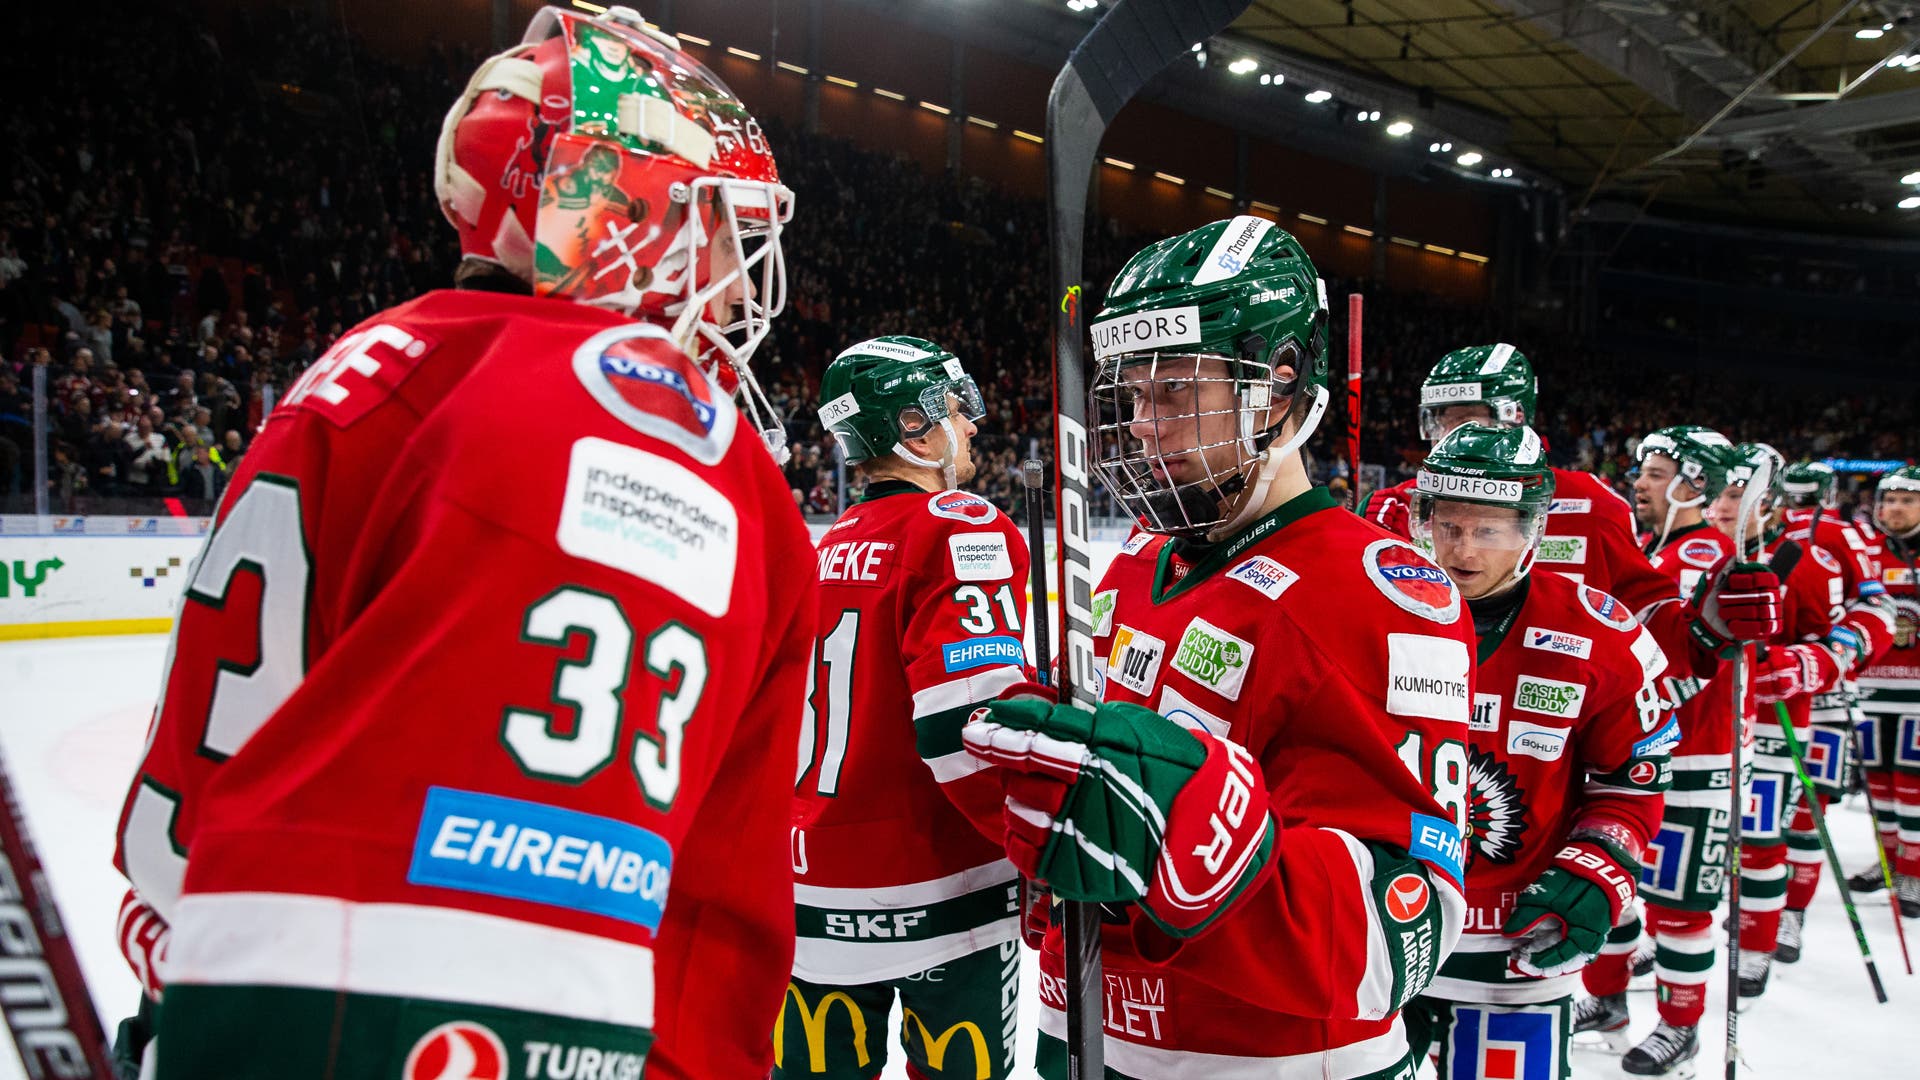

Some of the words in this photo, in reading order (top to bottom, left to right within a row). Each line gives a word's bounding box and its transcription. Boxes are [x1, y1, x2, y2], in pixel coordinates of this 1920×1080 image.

[605, 358, 712, 423] VOLO
[823, 399, 851, 421] ORS
[1431, 475, 1518, 498] BJURFORS
[587, 466, 728, 541] independent
[583, 489, 705, 550] inspection
[1227, 516, 1277, 558] BAUER
[956, 543, 1003, 555] independent
[957, 552, 997, 562] inspection
[1244, 568, 1277, 591] SPORT
[1253, 559, 1289, 581] INTER
[1384, 567, 1448, 584] VOLVO
[953, 584, 1022, 635] 31
[1186, 628, 1221, 659] CASH
[1551, 642, 1581, 654] SPORT
[1553, 635, 1582, 646] INTER
[1178, 645, 1226, 686] BUDDY
[499, 583, 709, 813] 33
[1518, 693, 1568, 713] BUDDY
[1521, 683, 1559, 700] CASH
[1521, 738, 1559, 753] BOHUS
[825, 910, 927, 938] SKF
[1105, 974, 1165, 1004] FILM
